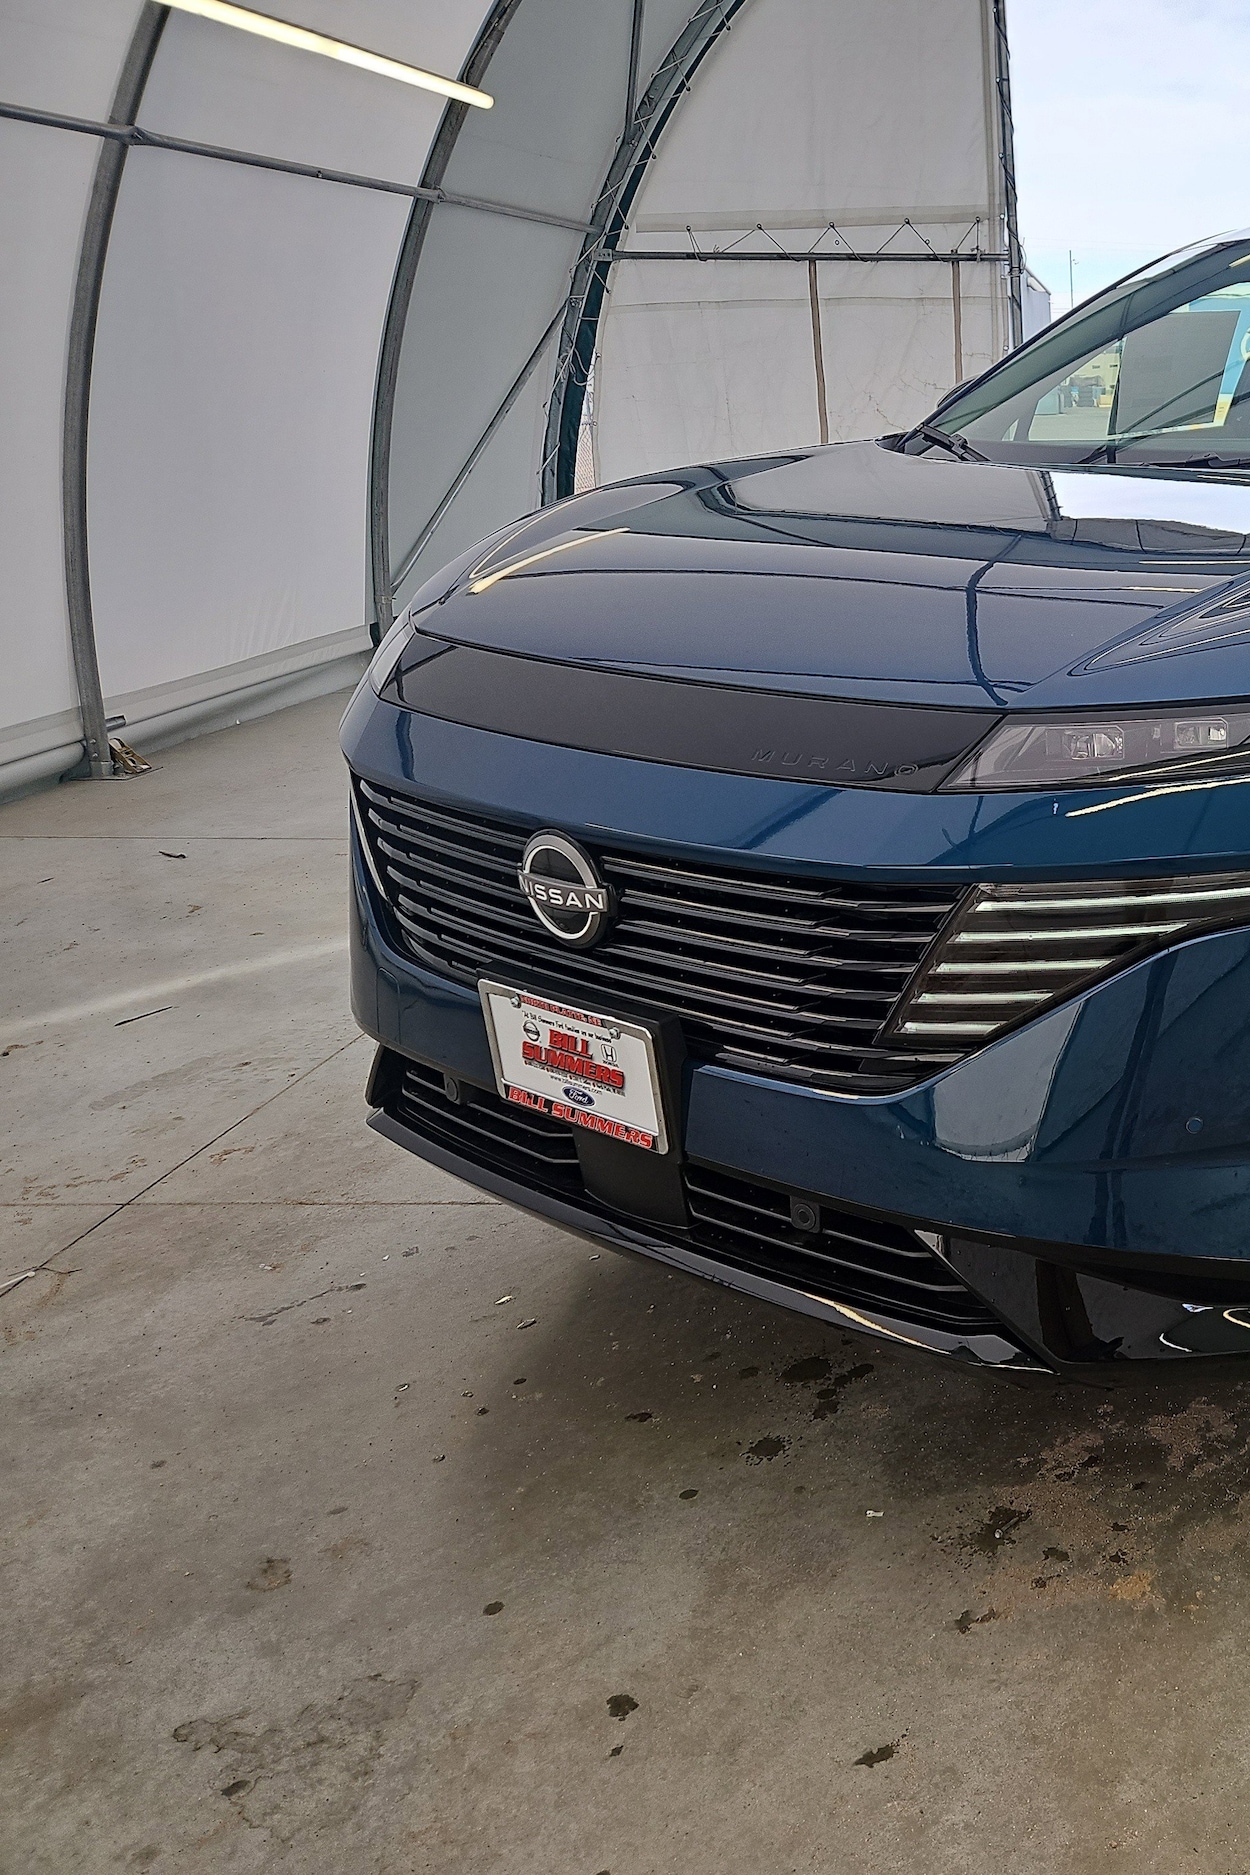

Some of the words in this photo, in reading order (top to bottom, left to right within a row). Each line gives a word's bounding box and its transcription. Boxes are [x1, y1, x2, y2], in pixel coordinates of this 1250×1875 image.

[751, 749, 919, 776] MURANO
[519, 874, 604, 910] NISSAN
[548, 1029, 593, 1059] BILL
[522, 1040, 626, 1089] SUMMERS
[569, 1088, 589, 1104] Ford
[508, 1086, 548, 1113] BILL
[552, 1102, 653, 1149] SUMMERS
